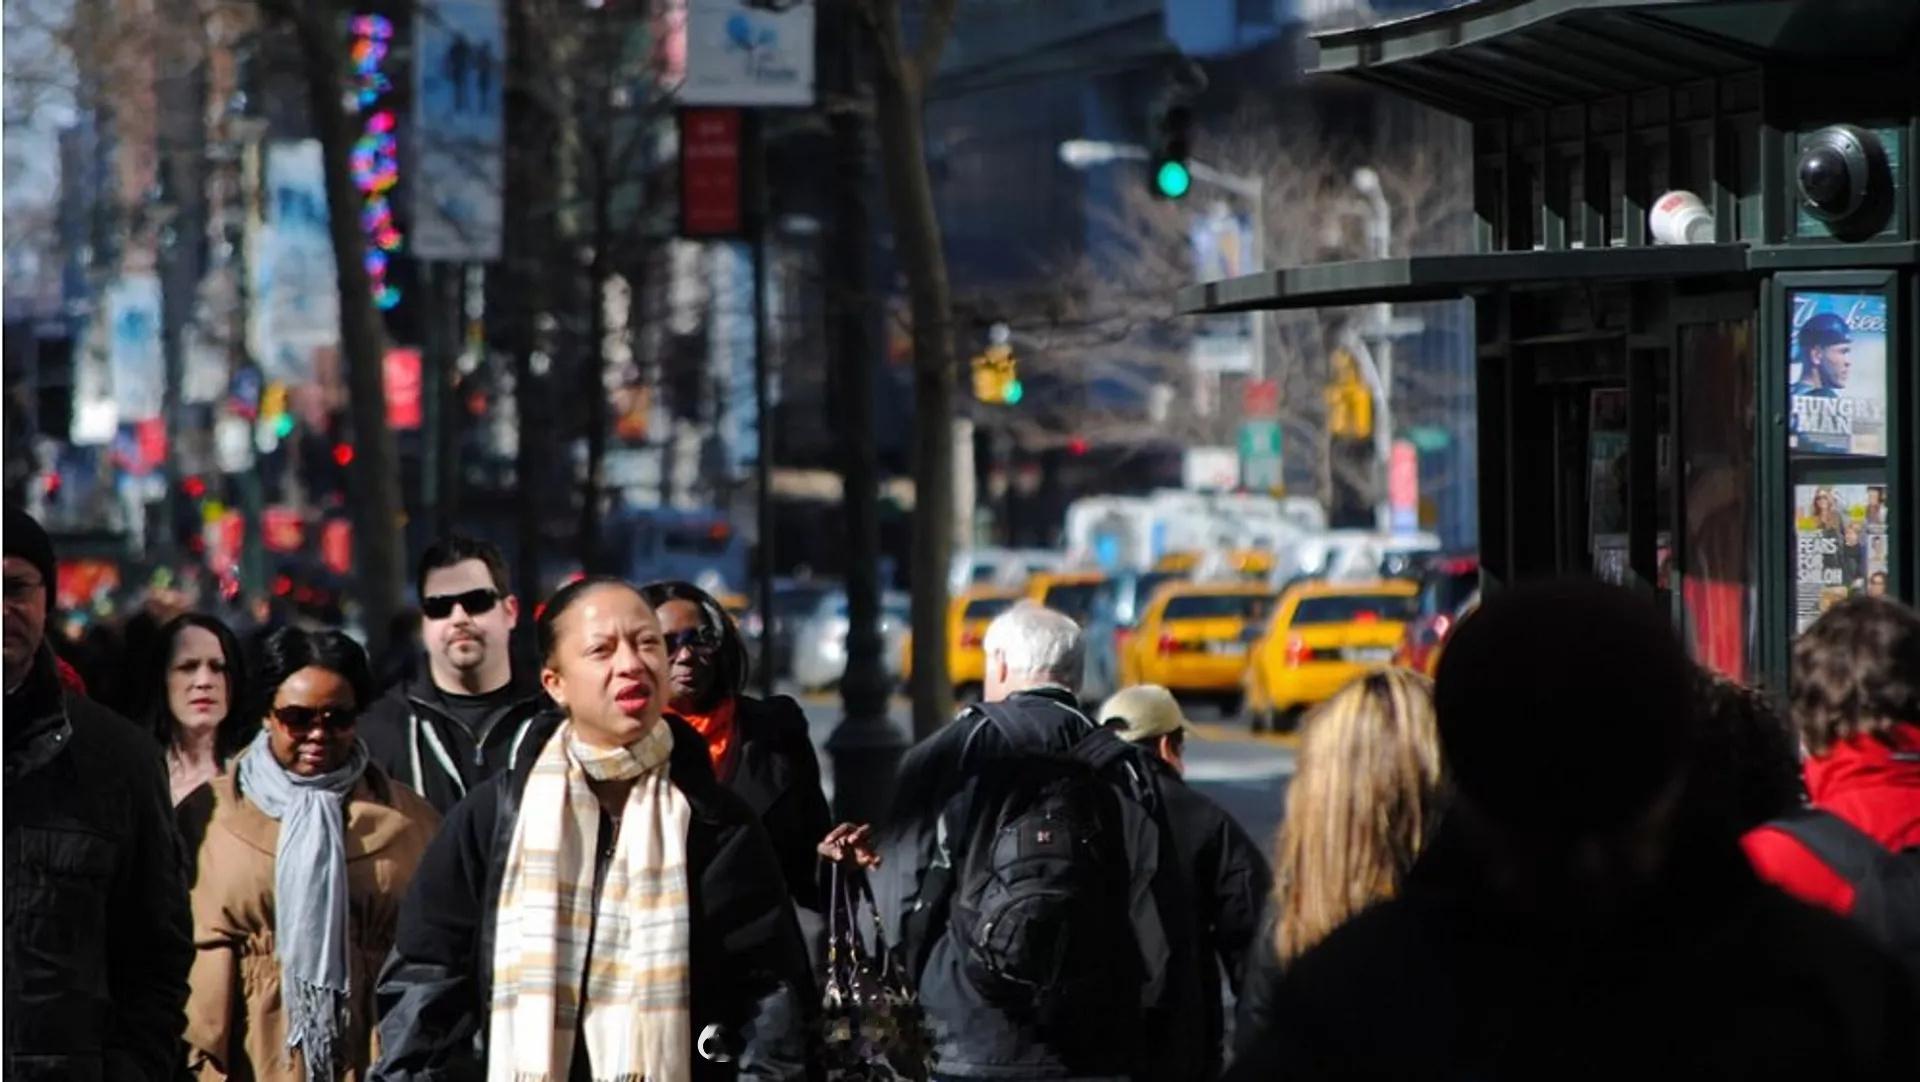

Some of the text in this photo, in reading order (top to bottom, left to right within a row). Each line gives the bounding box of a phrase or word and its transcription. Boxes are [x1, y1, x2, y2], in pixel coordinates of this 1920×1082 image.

[1791, 395, 1884, 419] HUNGRY
[1798, 414, 1852, 434] MAN
[1798, 537, 1837, 554] FEARS
